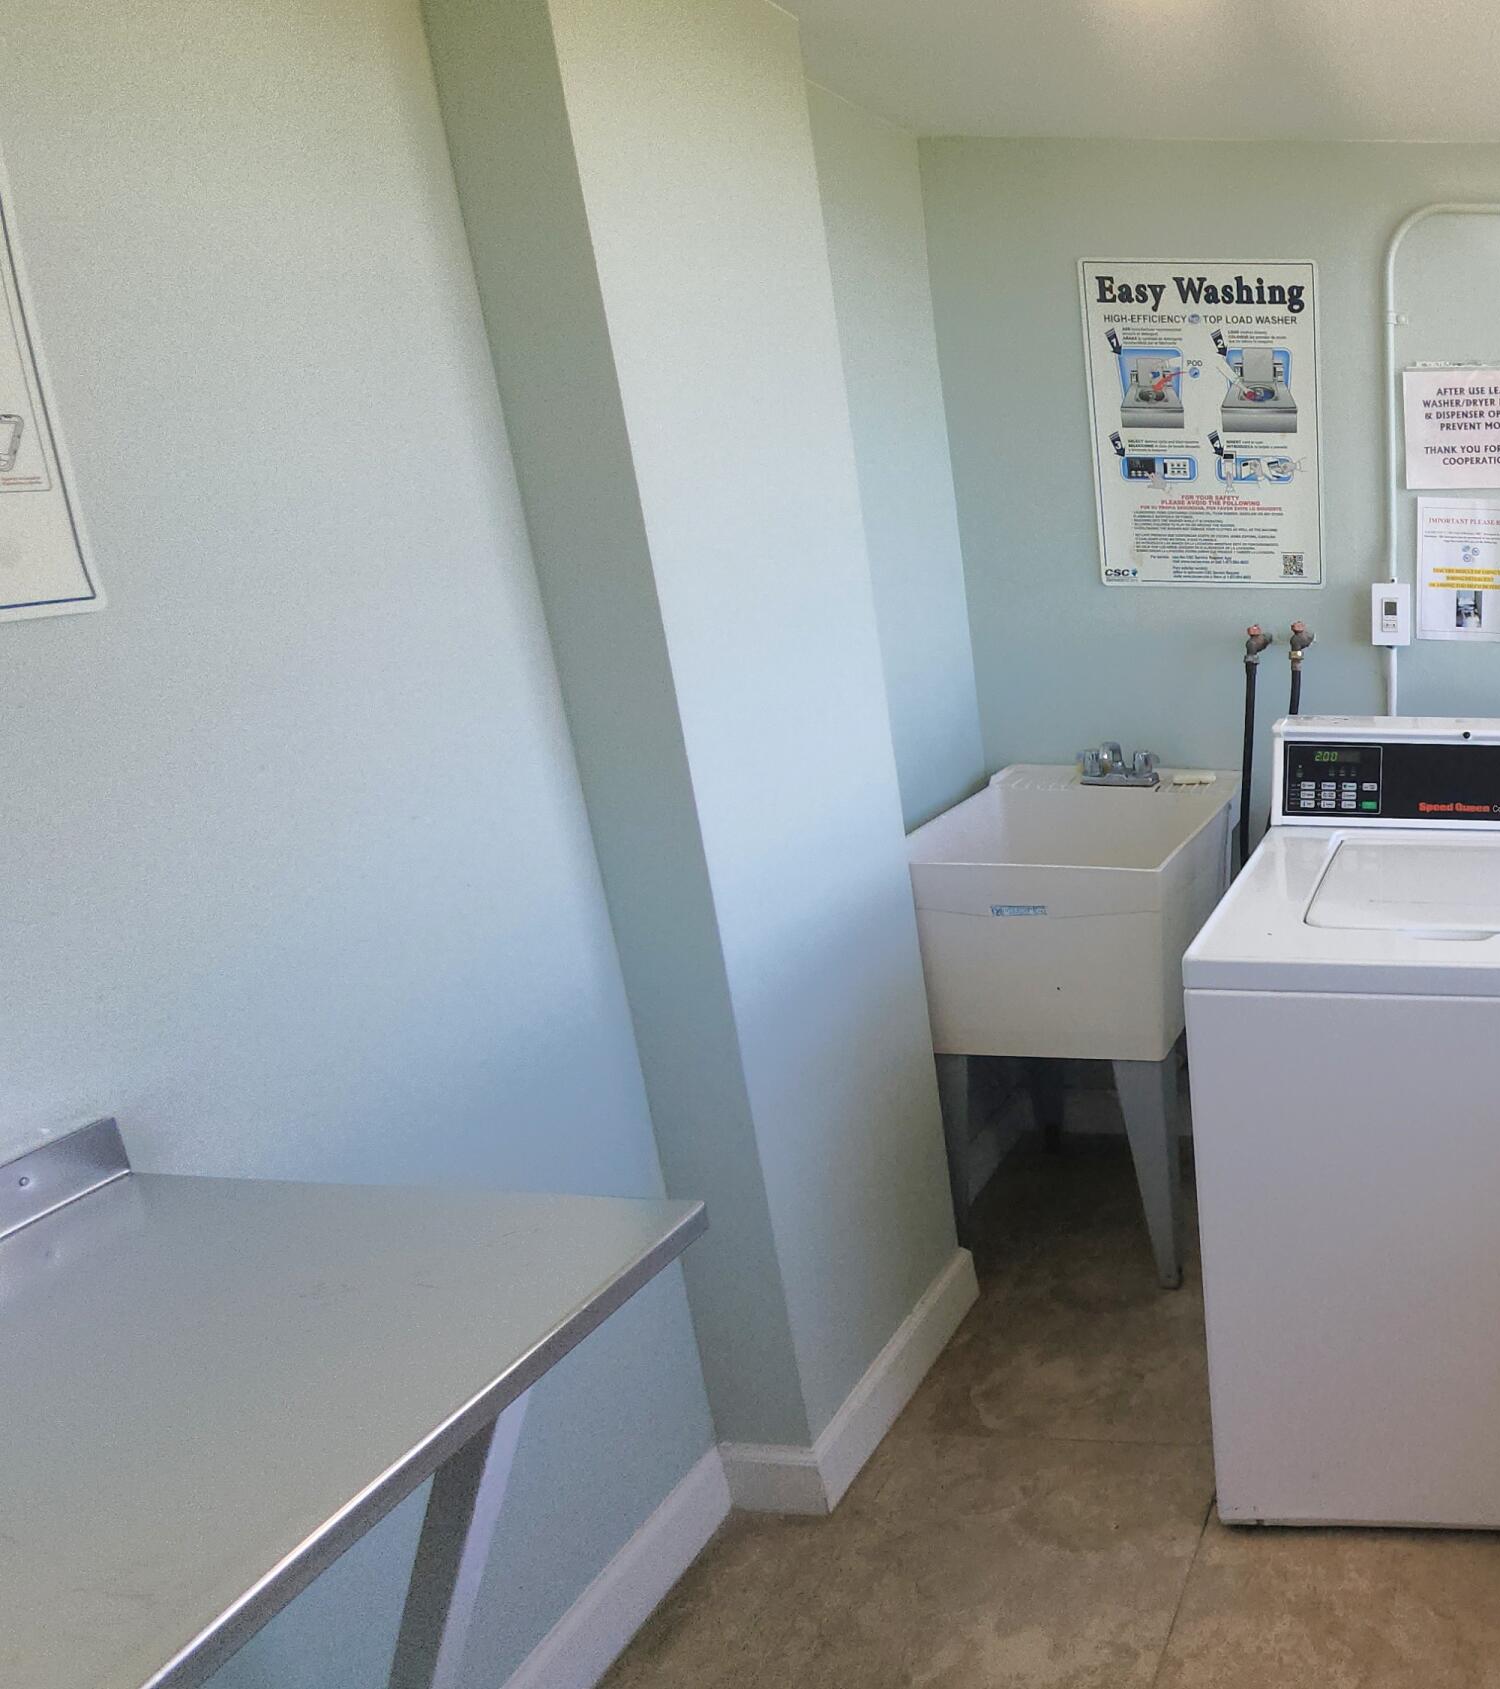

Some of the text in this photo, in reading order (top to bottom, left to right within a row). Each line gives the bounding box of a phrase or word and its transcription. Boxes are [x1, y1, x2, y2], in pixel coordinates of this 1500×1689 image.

[1095, 275, 1305, 313] Easy Washing
[1103, 314, 1187, 323] HIGH-EFFICIENCY
[1203, 315, 1222, 324] TOP
[1225, 315, 1253, 324] LOAD
[1255, 316, 1298, 325] WASHER
[1216, 339, 1224, 348] 2
[1436, 387, 1465, 396] AFTER
[1468, 387, 1485, 395] USE
[1422, 398, 1495, 408] WASHER/DRYER
[1424, 412, 1432, 420] &
[1435, 410, 1485, 419] DISPENSER
[1440, 422, 1481, 431] PREVENT
[1115, 440, 1121, 450] 3
[1424, 446, 1457, 454] THANK
[1460, 445, 1480, 453] YOU
[1428, 517, 1469, 525] IMPORTANT
[1470, 518, 1496, 526] PLEASE
[1105, 568, 1130, 577] CSC
[1419, 802, 1454, 813] Speed
[1455, 802, 1490, 813] Queen
